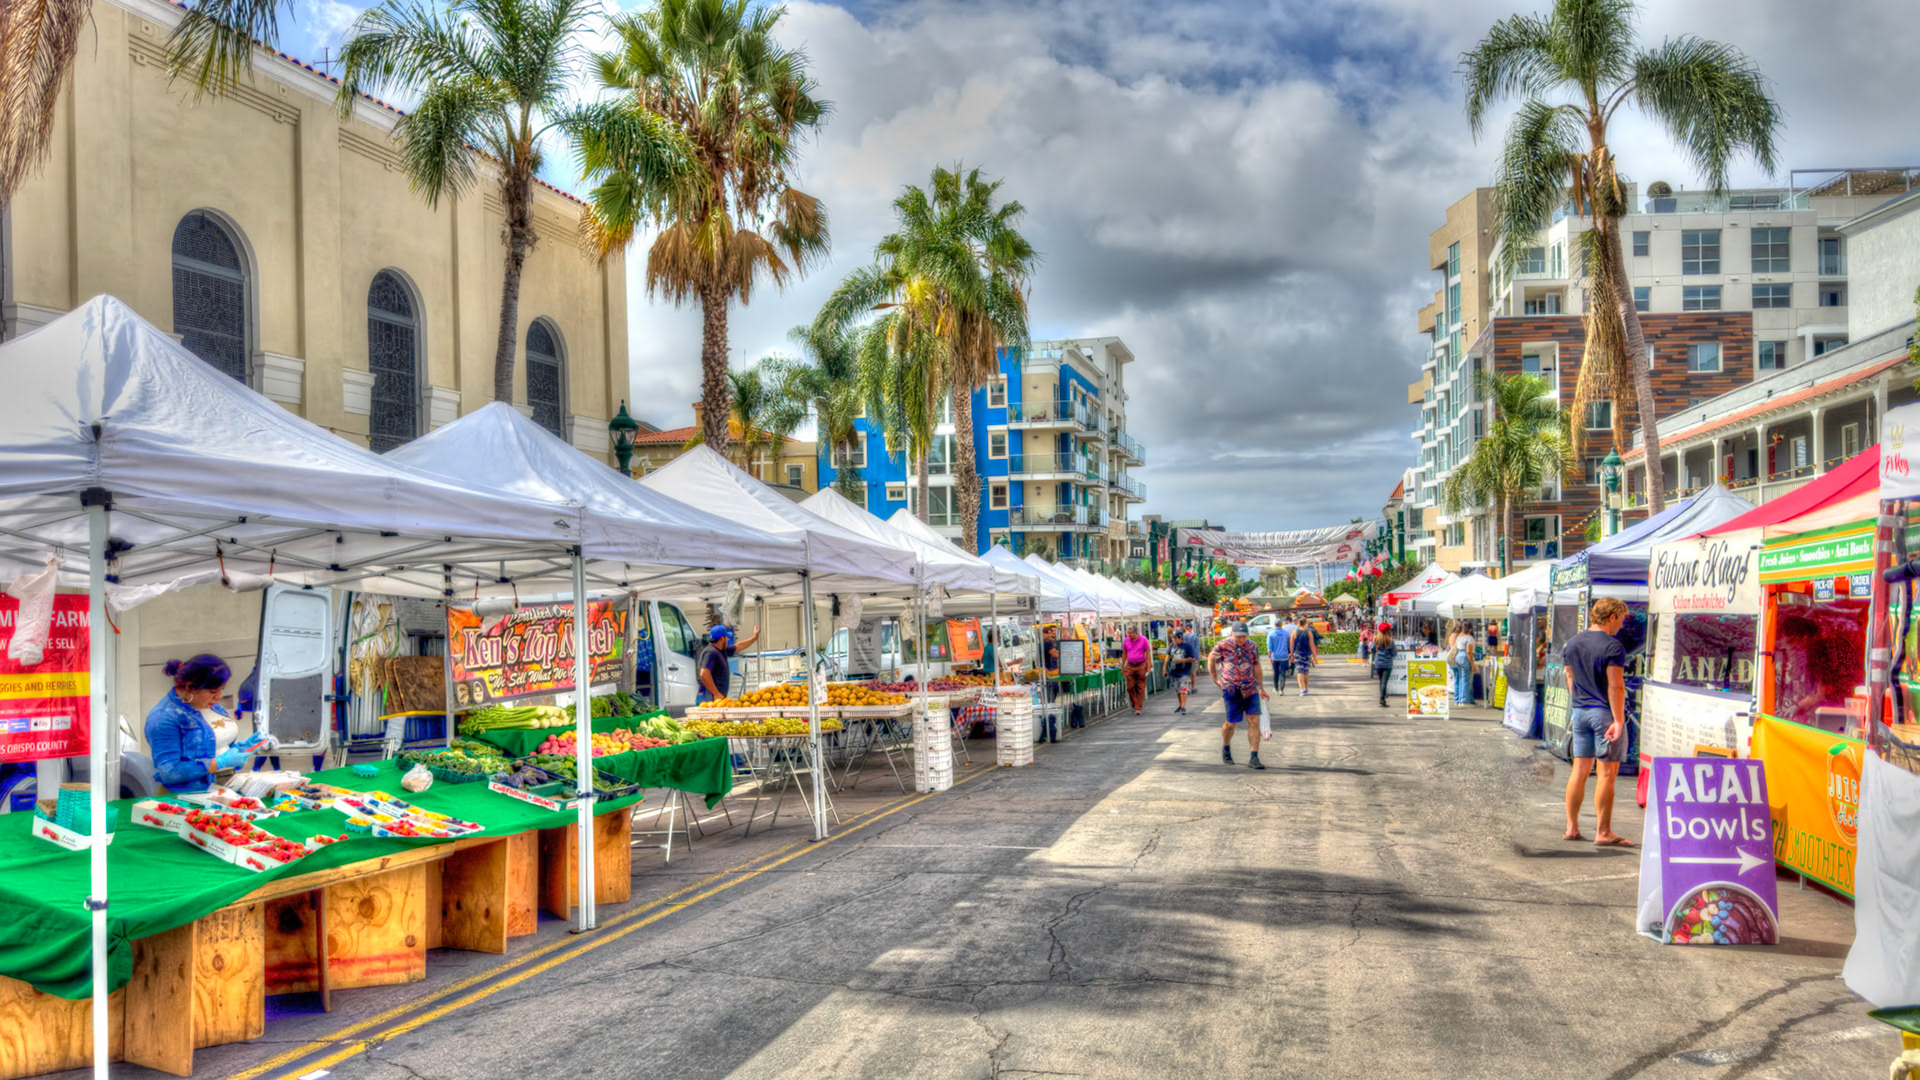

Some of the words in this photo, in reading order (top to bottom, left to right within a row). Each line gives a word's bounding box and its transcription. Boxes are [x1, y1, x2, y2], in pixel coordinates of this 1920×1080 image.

[1761, 555, 1778, 567] Fresh
[1778, 554, 1796, 566] Juices
[1800, 548, 1830, 562] Smoothies
[1834, 543, 1849, 558] Acai
[1850, 540, 1870, 555] Bowls
[1655, 550, 1700, 590] Cubano
[1702, 540, 1751, 604] Kings
[1852, 574, 1870, 586] ORDER
[1673, 594, 1690, 610] Cuban
[1692, 594, 1726, 609] Sandwiches
[56, 638, 75, 649] SELL
[463, 626, 521, 669] Ken's
[522, 625, 559, 669] Top
[559, 619, 615, 658] Ntch
[25, 682, 44, 692] AND
[46, 680, 76, 690] BERRIES
[509, 672, 526, 687] Sell
[528, 668, 552, 684] What
[553, 666, 568, 680] We
[7, 742, 35, 754] OBISPO
[36, 740, 68, 752] COUNTY
[1664, 762, 1764, 804] ACAI
[1666, 806, 1766, 841] bowls
